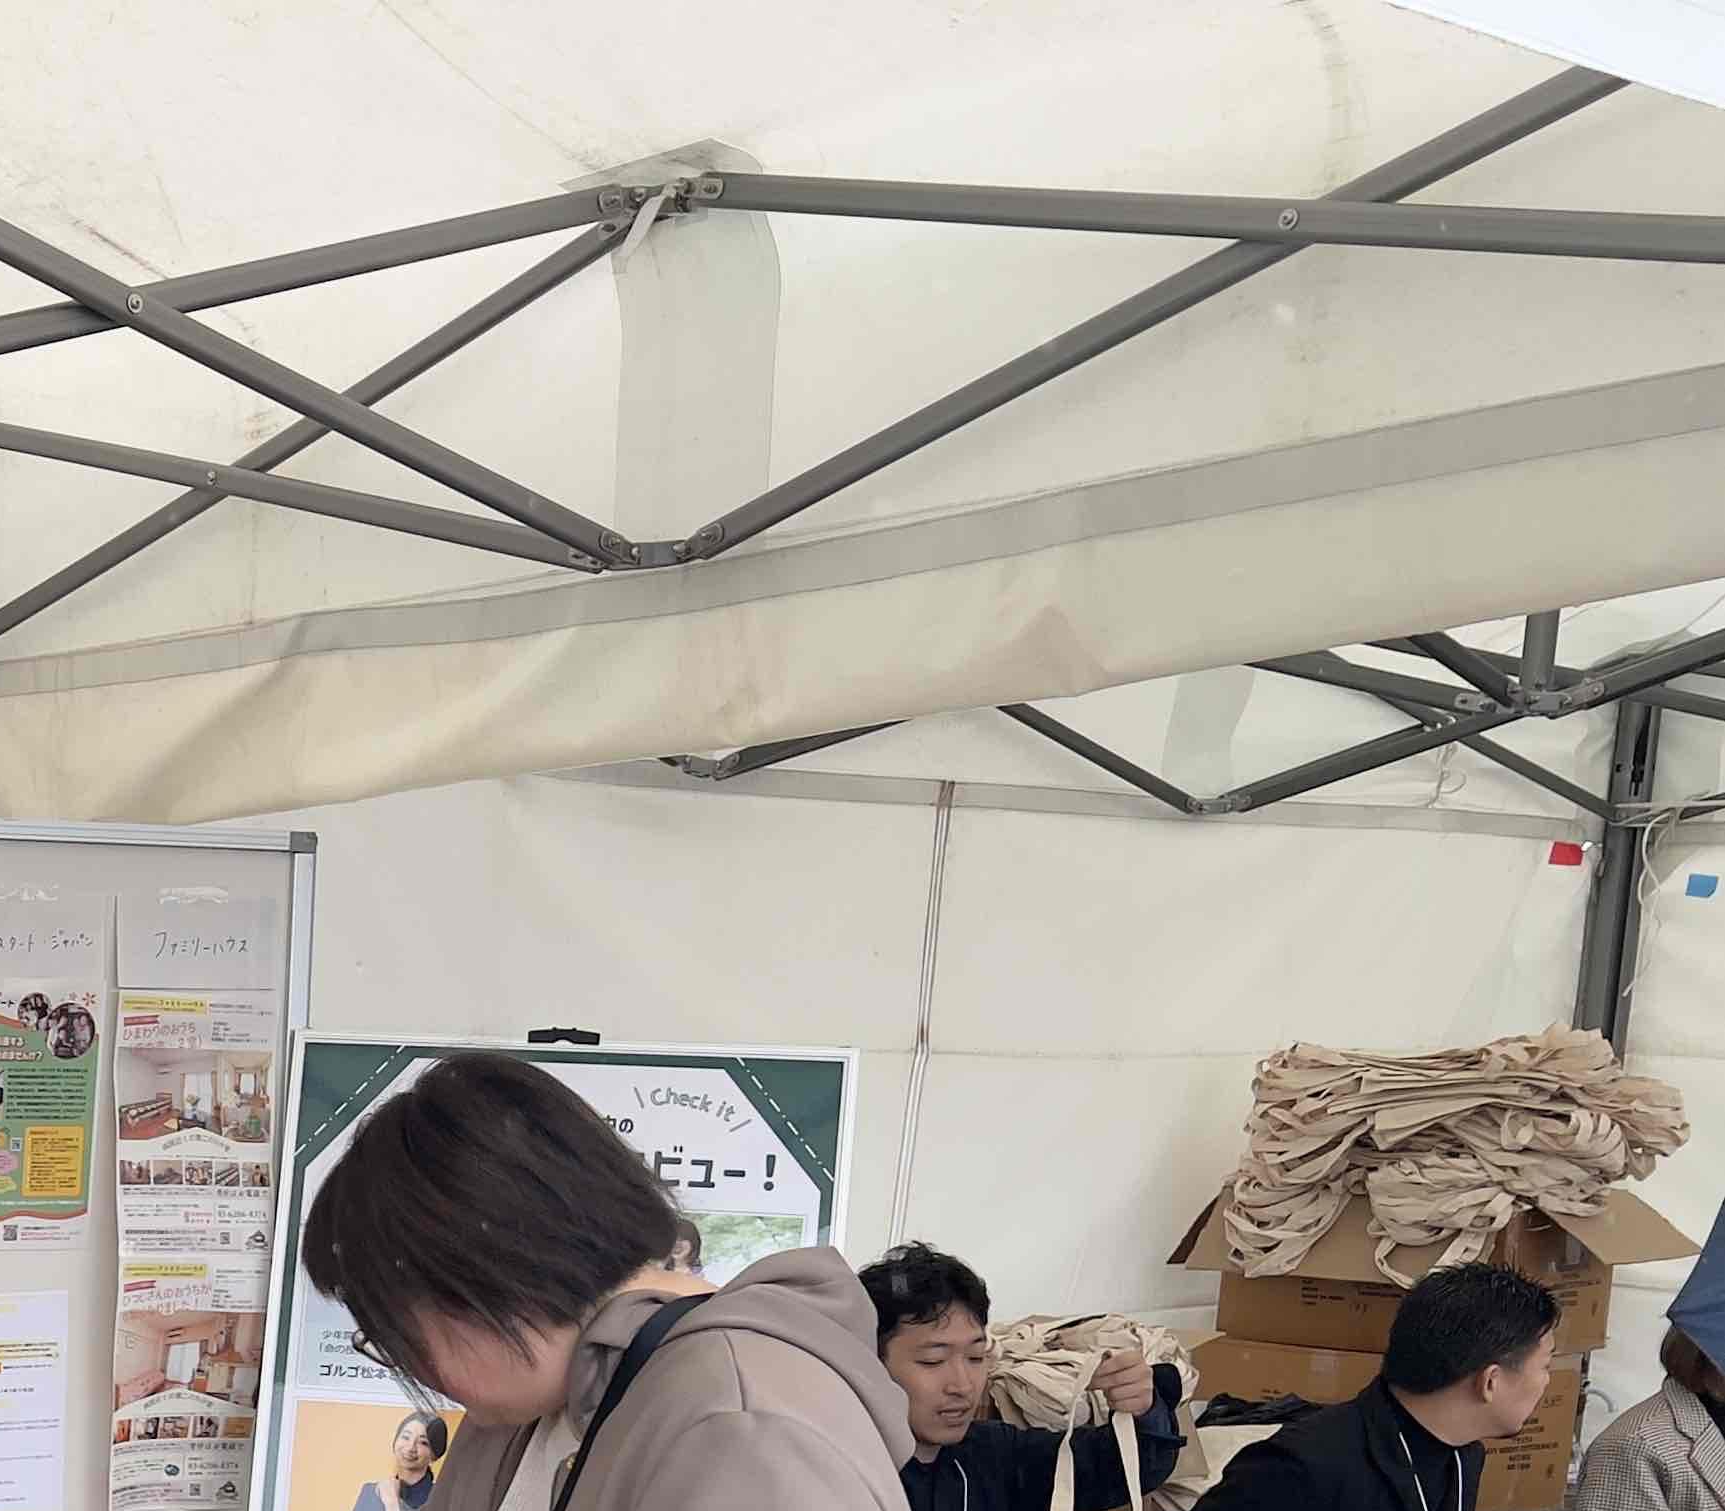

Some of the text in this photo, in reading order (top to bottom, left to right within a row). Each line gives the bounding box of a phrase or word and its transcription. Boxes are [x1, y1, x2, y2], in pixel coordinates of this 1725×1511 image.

[155, 930, 249, 959] ファミリーハウス
[715, 1100, 737, 1122] it
